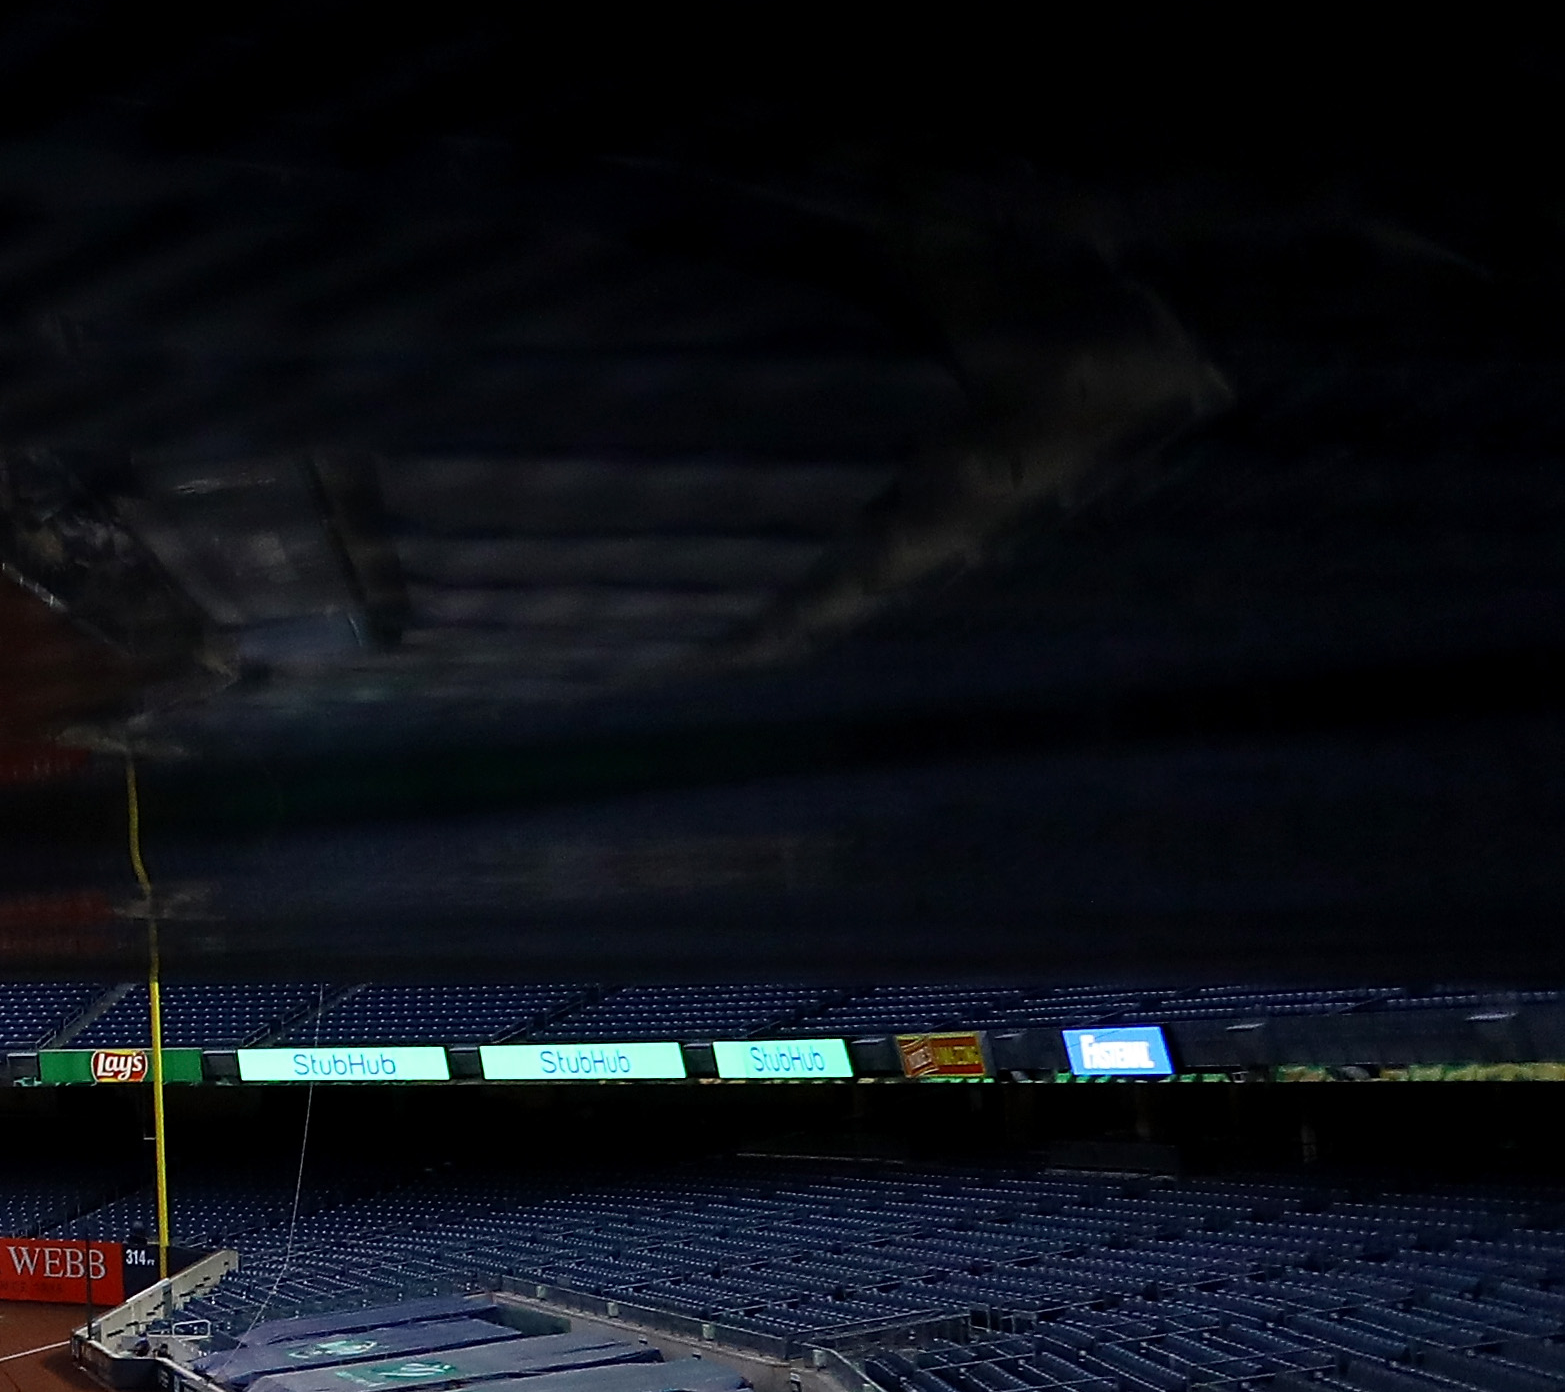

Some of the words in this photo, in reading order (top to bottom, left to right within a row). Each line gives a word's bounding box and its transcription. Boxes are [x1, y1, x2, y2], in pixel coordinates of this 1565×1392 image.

[95, 1051, 145, 1078] Lay's
[292, 1054, 397, 1077] StubHub
[541, 1051, 632, 1073] StubHub
[750, 1047, 825, 1072] StubHub
[7, 1246, 107, 1280] WEBB
[125, 1249, 146, 1266] 314
